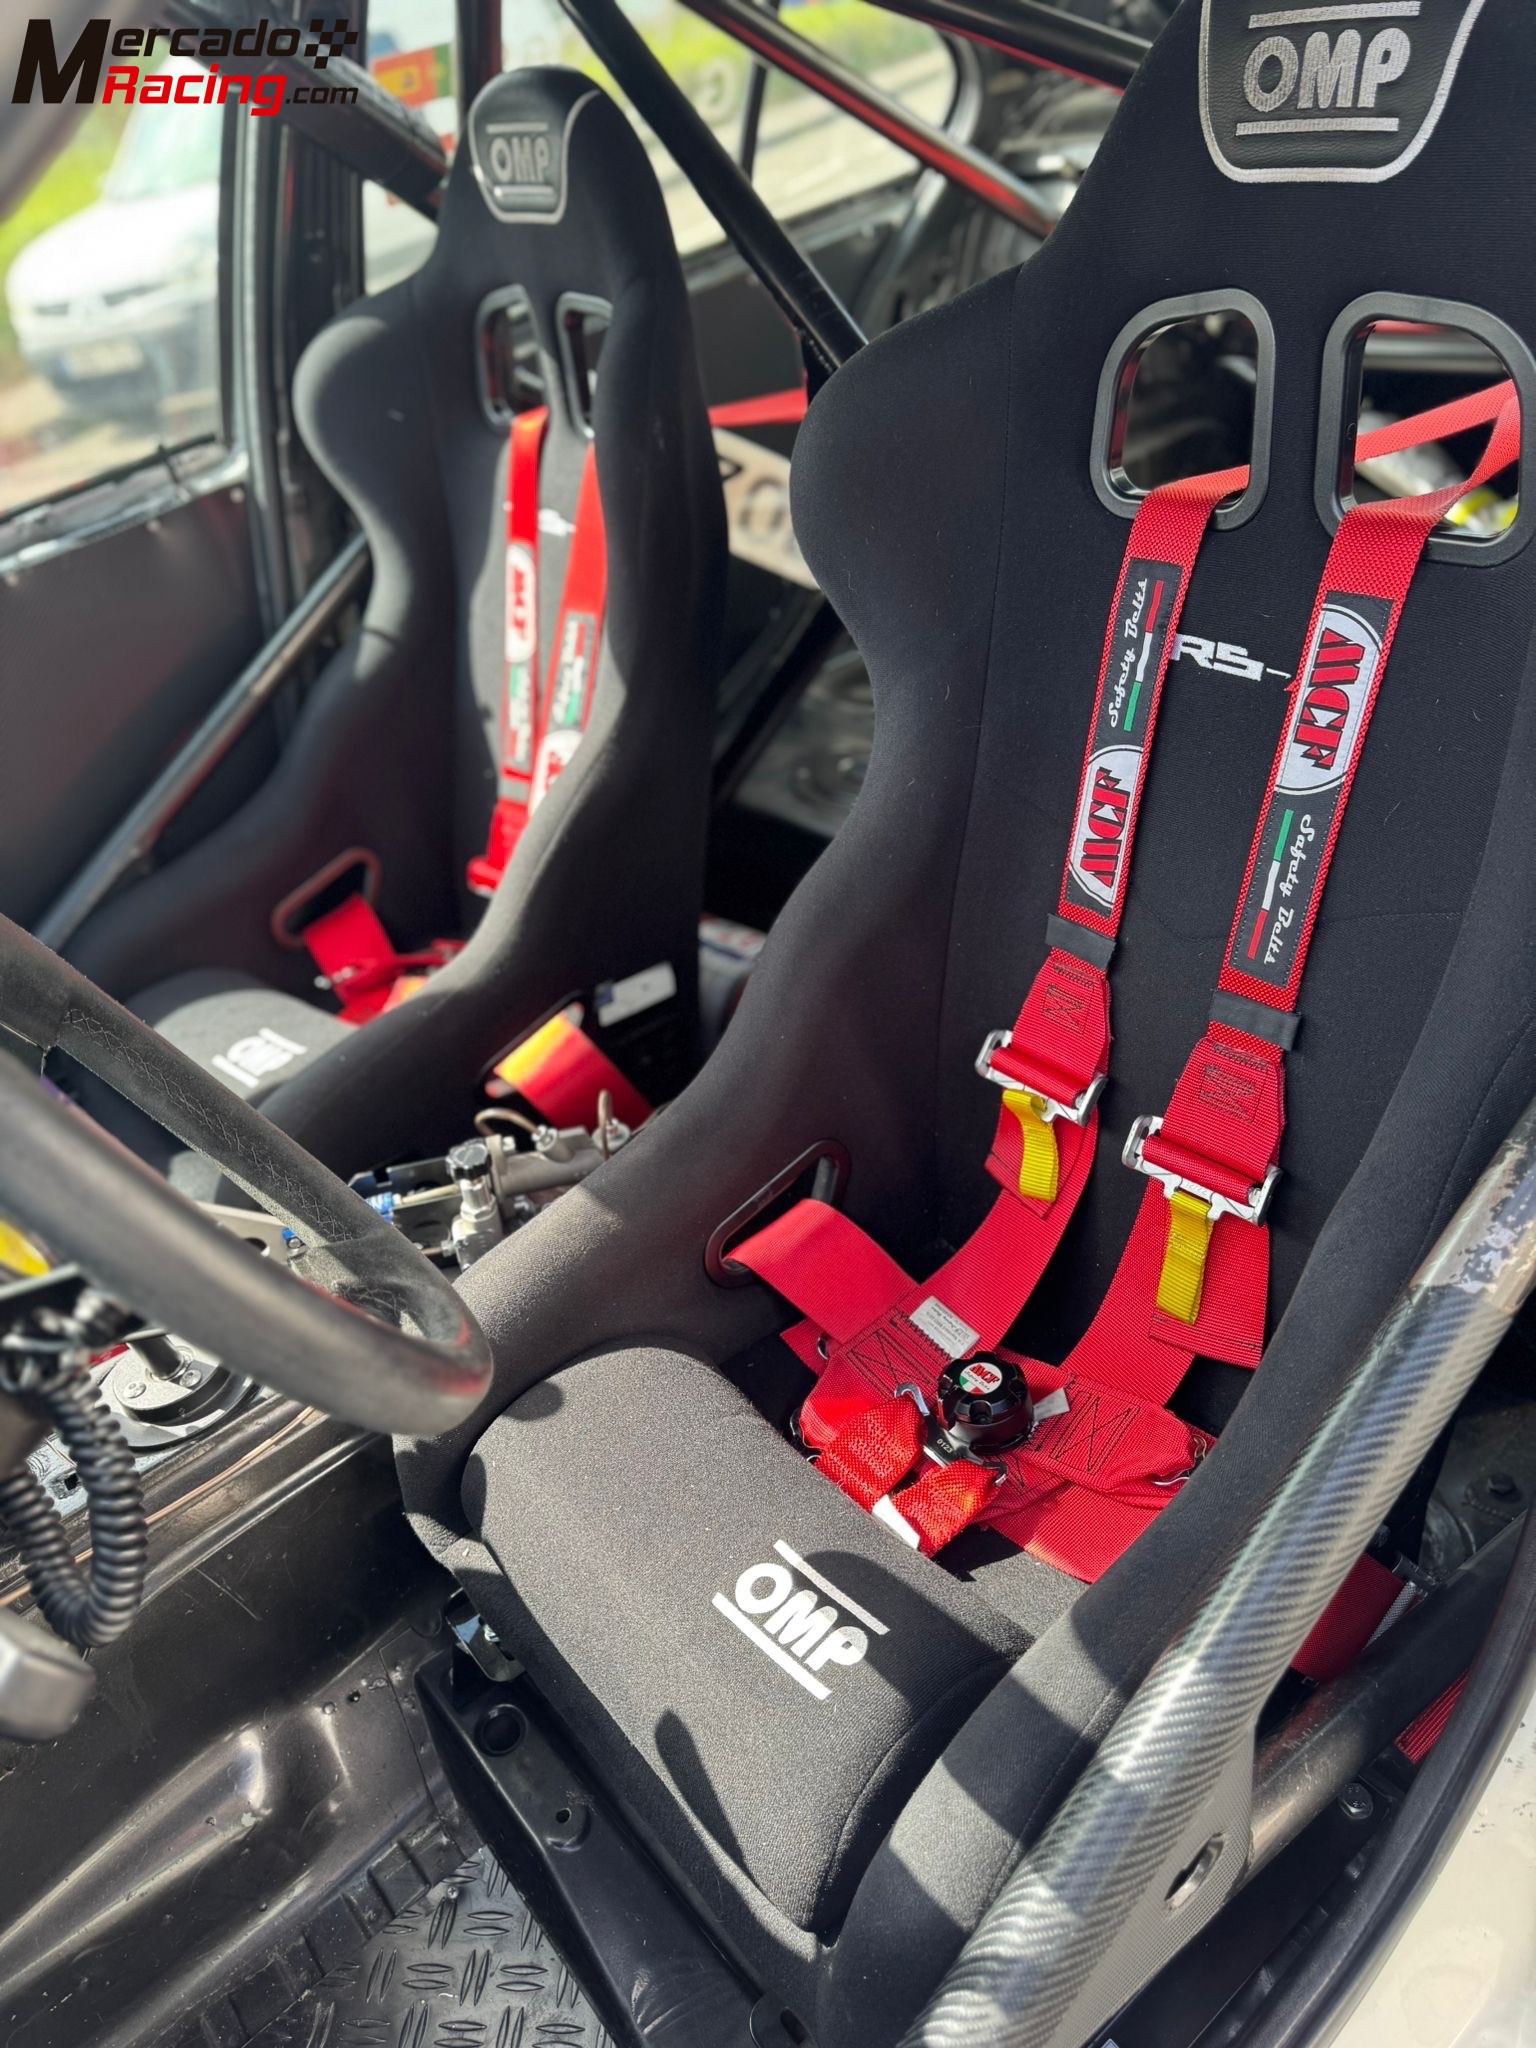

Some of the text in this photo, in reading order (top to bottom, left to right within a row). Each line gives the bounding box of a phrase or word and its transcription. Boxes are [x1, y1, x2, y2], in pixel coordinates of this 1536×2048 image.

[1242, 27, 1411, 113] OMP
[489, 136, 550, 183] OMP
[1108, 578, 1148, 728] Safety Belts
[1263, 813, 1316, 965] Safety Belts
[936, 1438, 953, 1454] 0123
[734, 1562, 869, 1672] OMP
